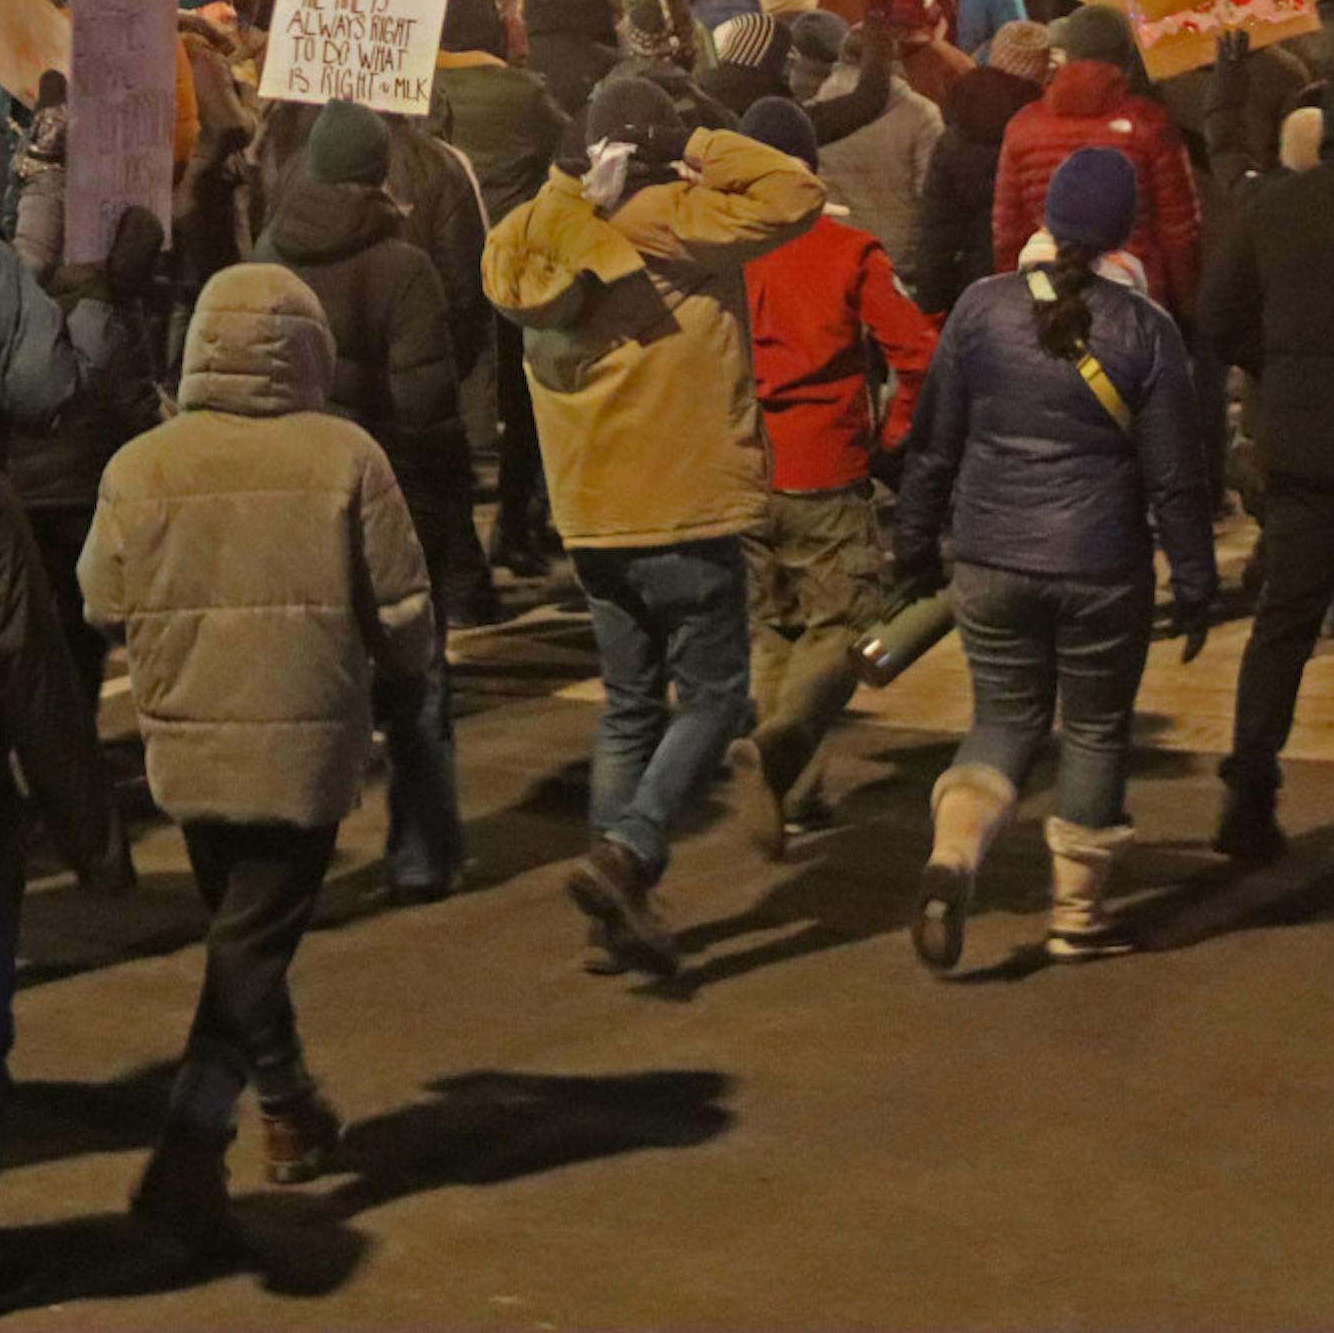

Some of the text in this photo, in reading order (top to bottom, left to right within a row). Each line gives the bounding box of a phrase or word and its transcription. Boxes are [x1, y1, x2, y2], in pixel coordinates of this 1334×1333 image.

[286, 10, 417, 48] ALWAYS RIGHT
[292, 36, 409, 72] TO DO WHAT
[288, 68, 310, 93] IS
[320, 67, 380, 101] RIGHT
[394, 76, 430, 102] MLK
